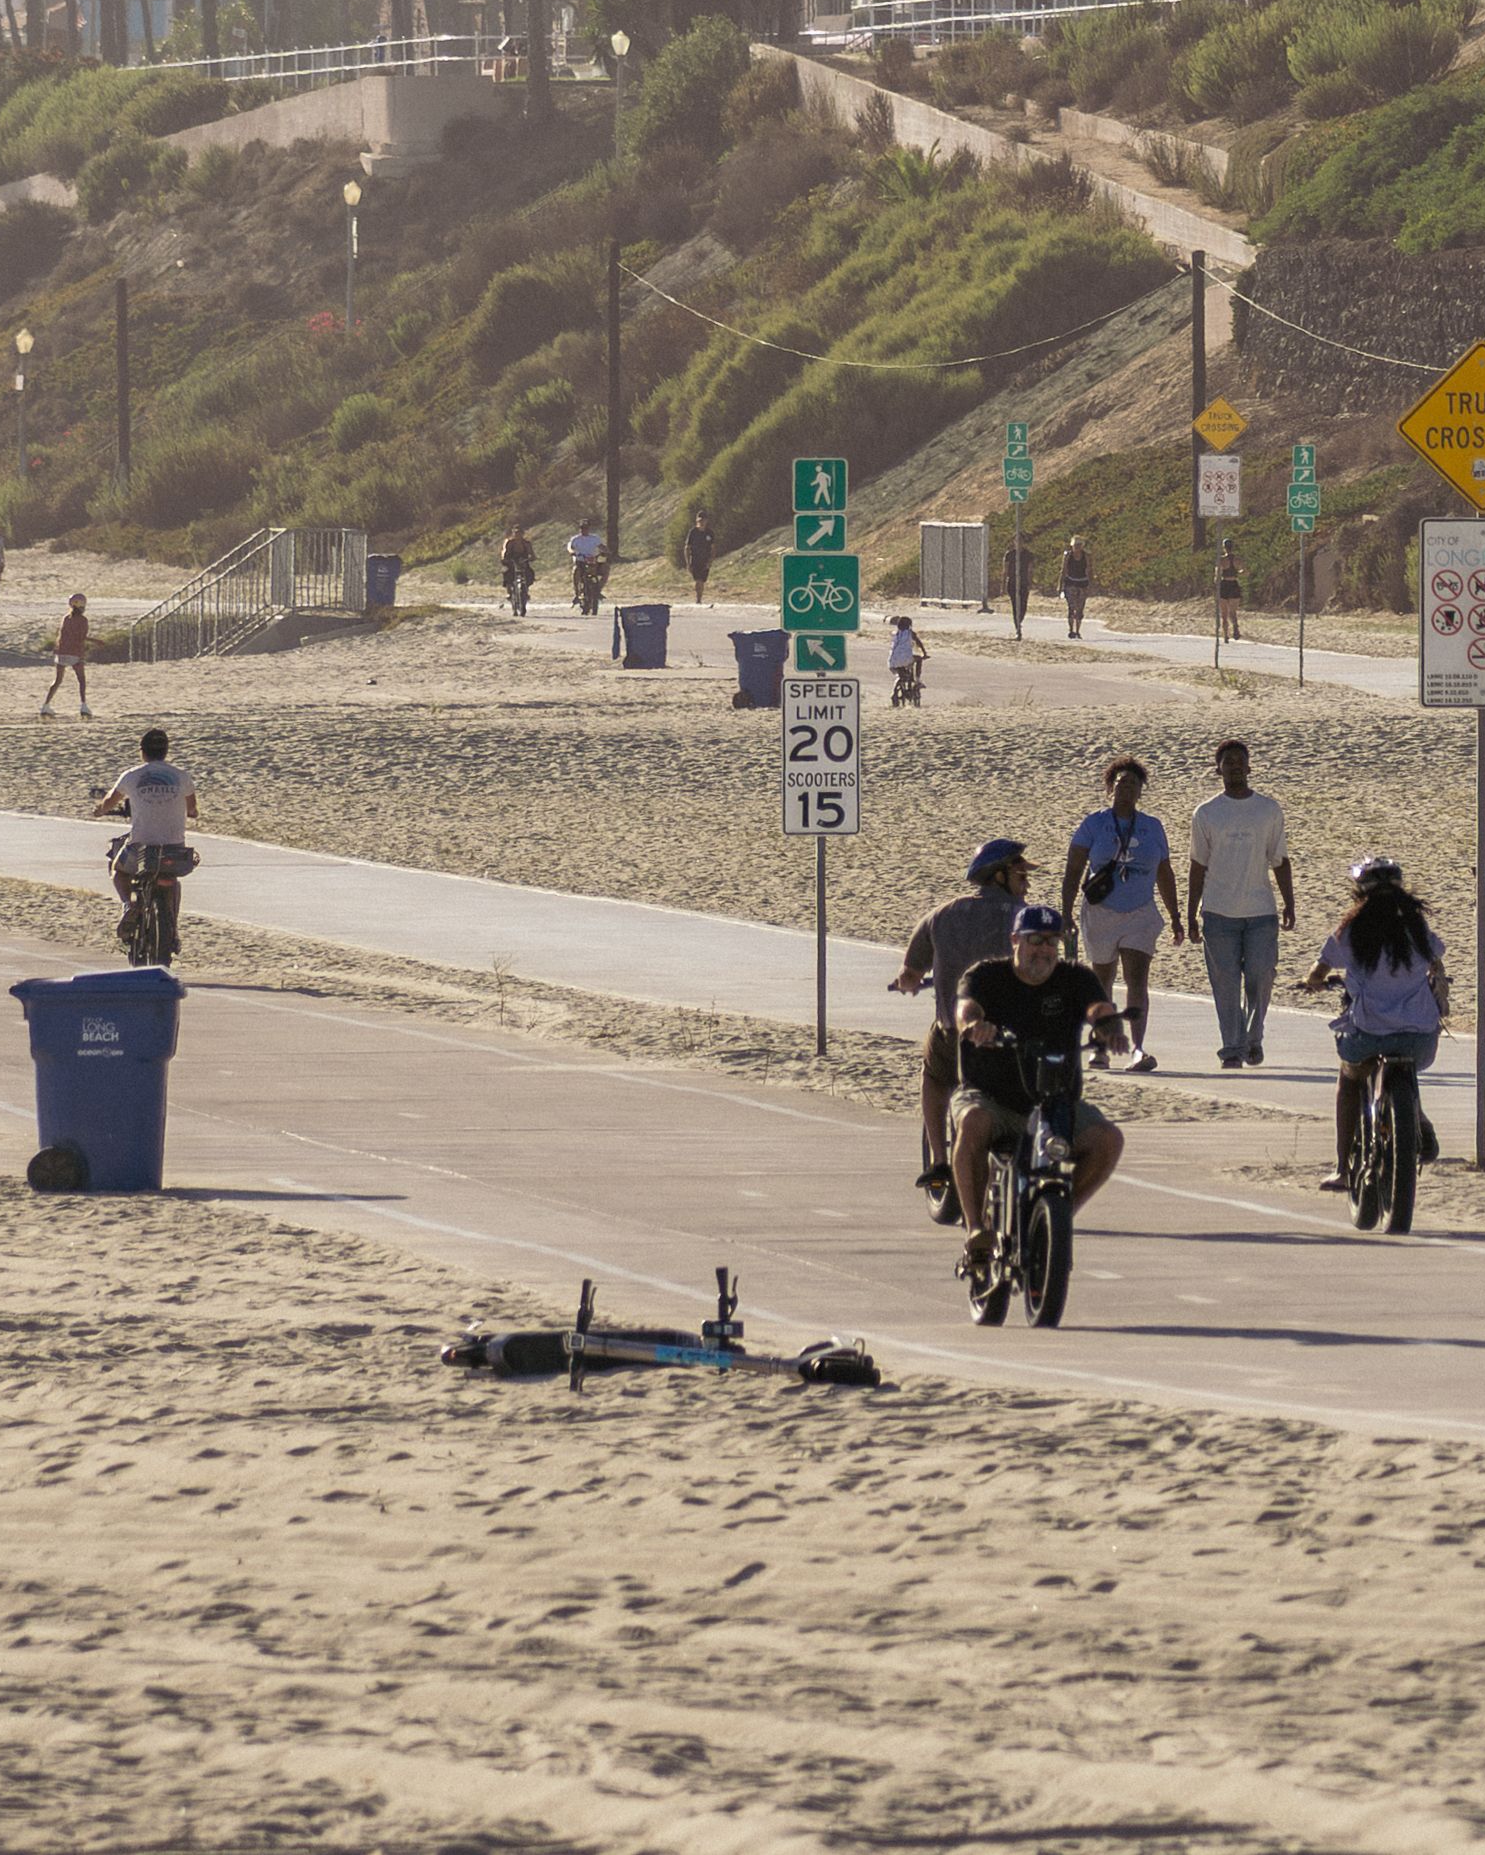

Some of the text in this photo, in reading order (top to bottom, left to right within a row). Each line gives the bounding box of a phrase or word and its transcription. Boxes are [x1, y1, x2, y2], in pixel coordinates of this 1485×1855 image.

[790, 683, 853, 699] SPEED
[796, 705, 846, 721] LIMIT
[789, 725, 854, 762] 20
[788, 772, 855, 788] SCOOTERS
[797, 792, 845, 829] 15
[82, 1023, 116, 1033] LONG
[82, 1032, 119, 1042] BEACH
